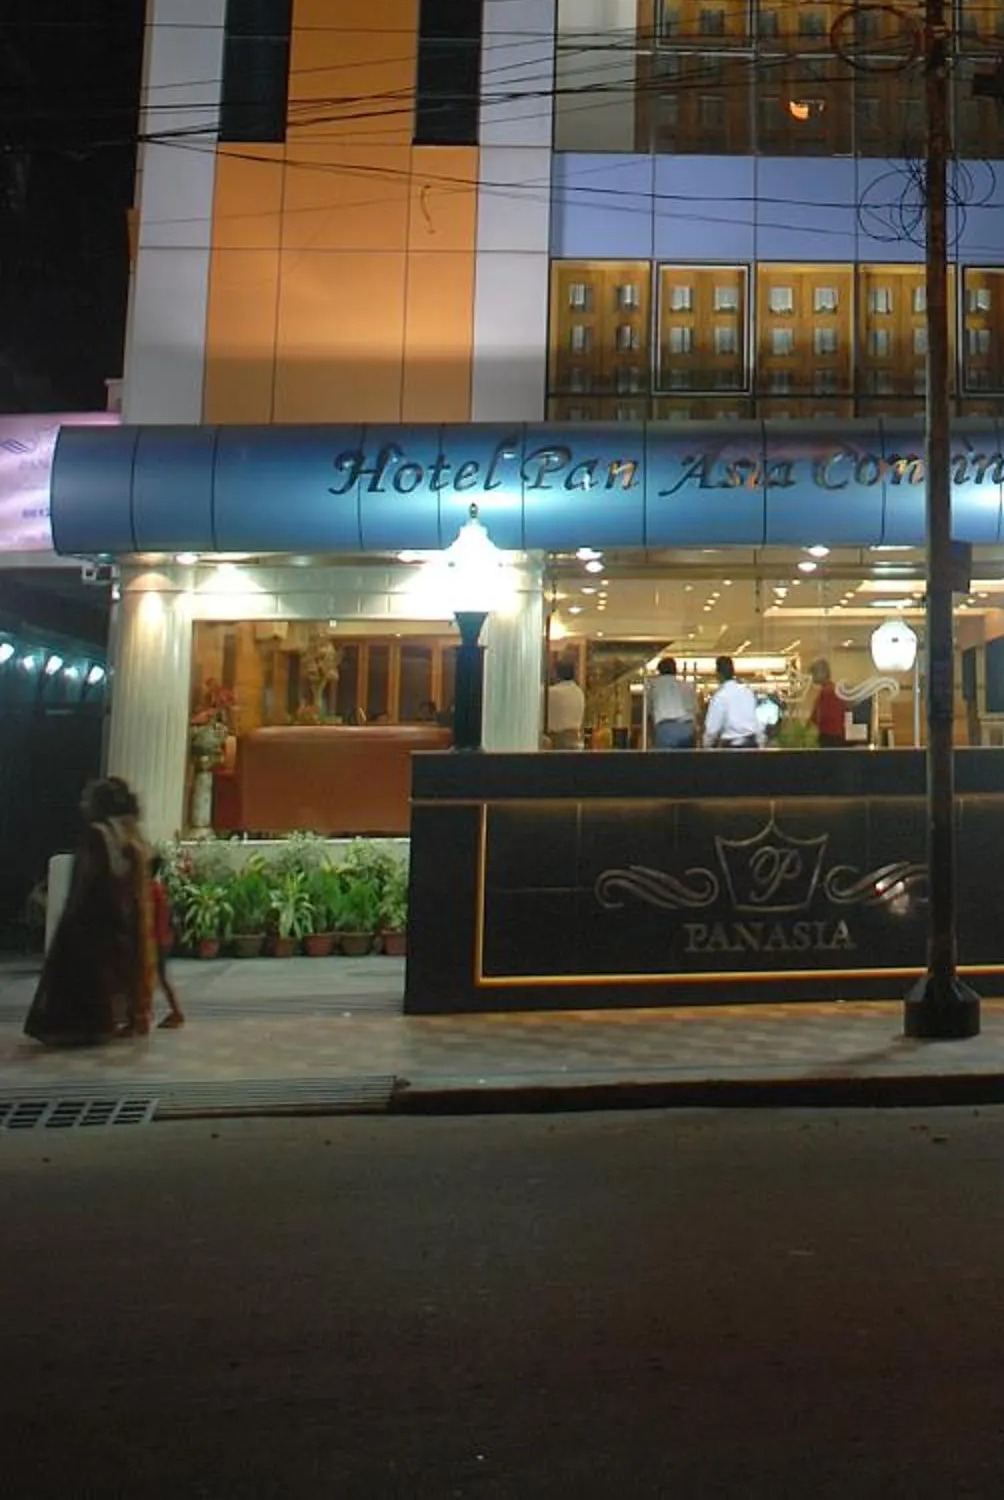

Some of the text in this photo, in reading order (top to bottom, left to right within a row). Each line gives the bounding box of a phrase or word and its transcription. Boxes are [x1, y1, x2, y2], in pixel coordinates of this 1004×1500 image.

[329, 433, 518, 496] Hotel
[519, 444, 640, 492] Pan
[658, 442, 796, 497] Asia
[682, 919, 856, 951] PANASIA
